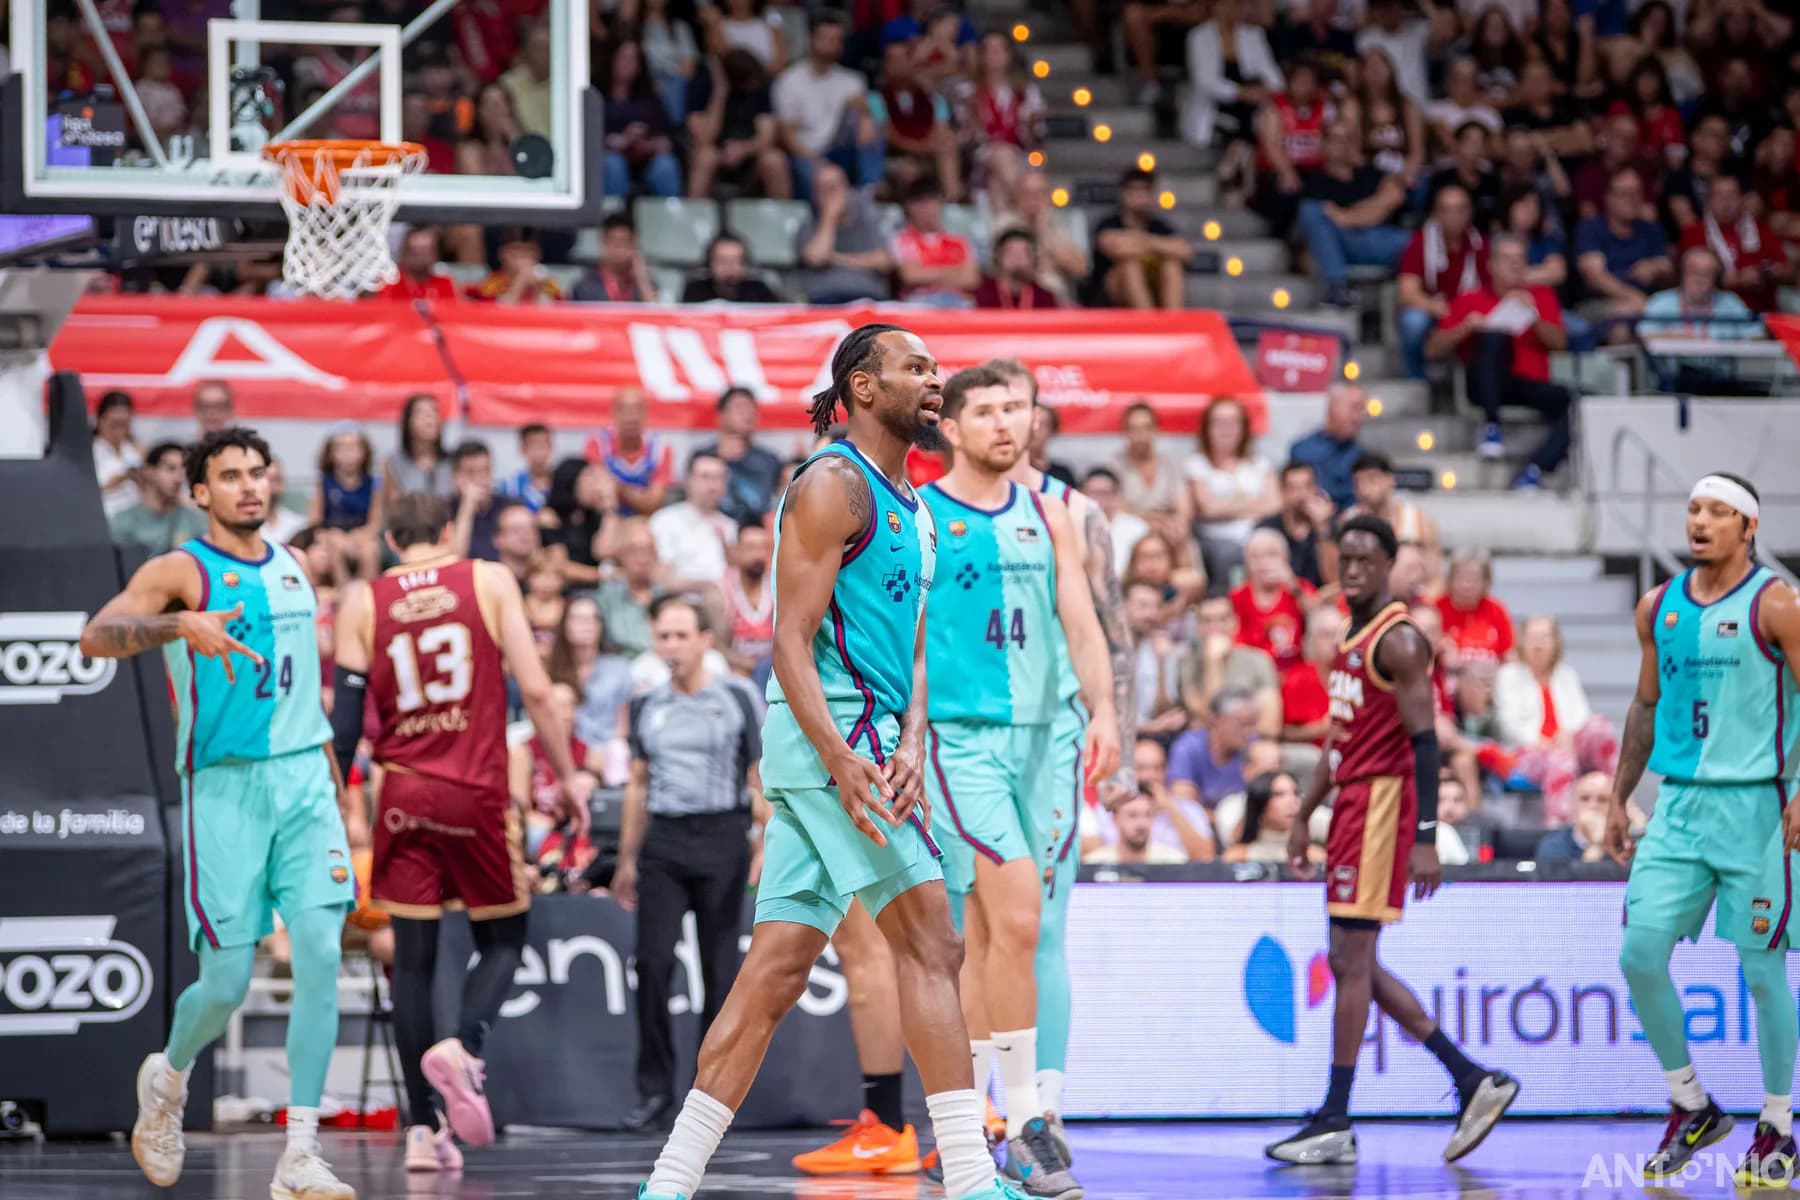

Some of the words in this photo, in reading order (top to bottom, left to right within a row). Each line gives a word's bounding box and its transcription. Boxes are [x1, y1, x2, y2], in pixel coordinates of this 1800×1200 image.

[985, 607, 1027, 650] 44
[0, 641, 106, 684] OZO
[255, 653, 293, 699] 24
[387, 622, 474, 712] 13
[1692, 699, 1709, 740] 5
[0, 810, 29, 834] de
[32, 810, 55, 834] la
[58, 808, 145, 839] familia
[0, 953, 143, 1010] OZO
